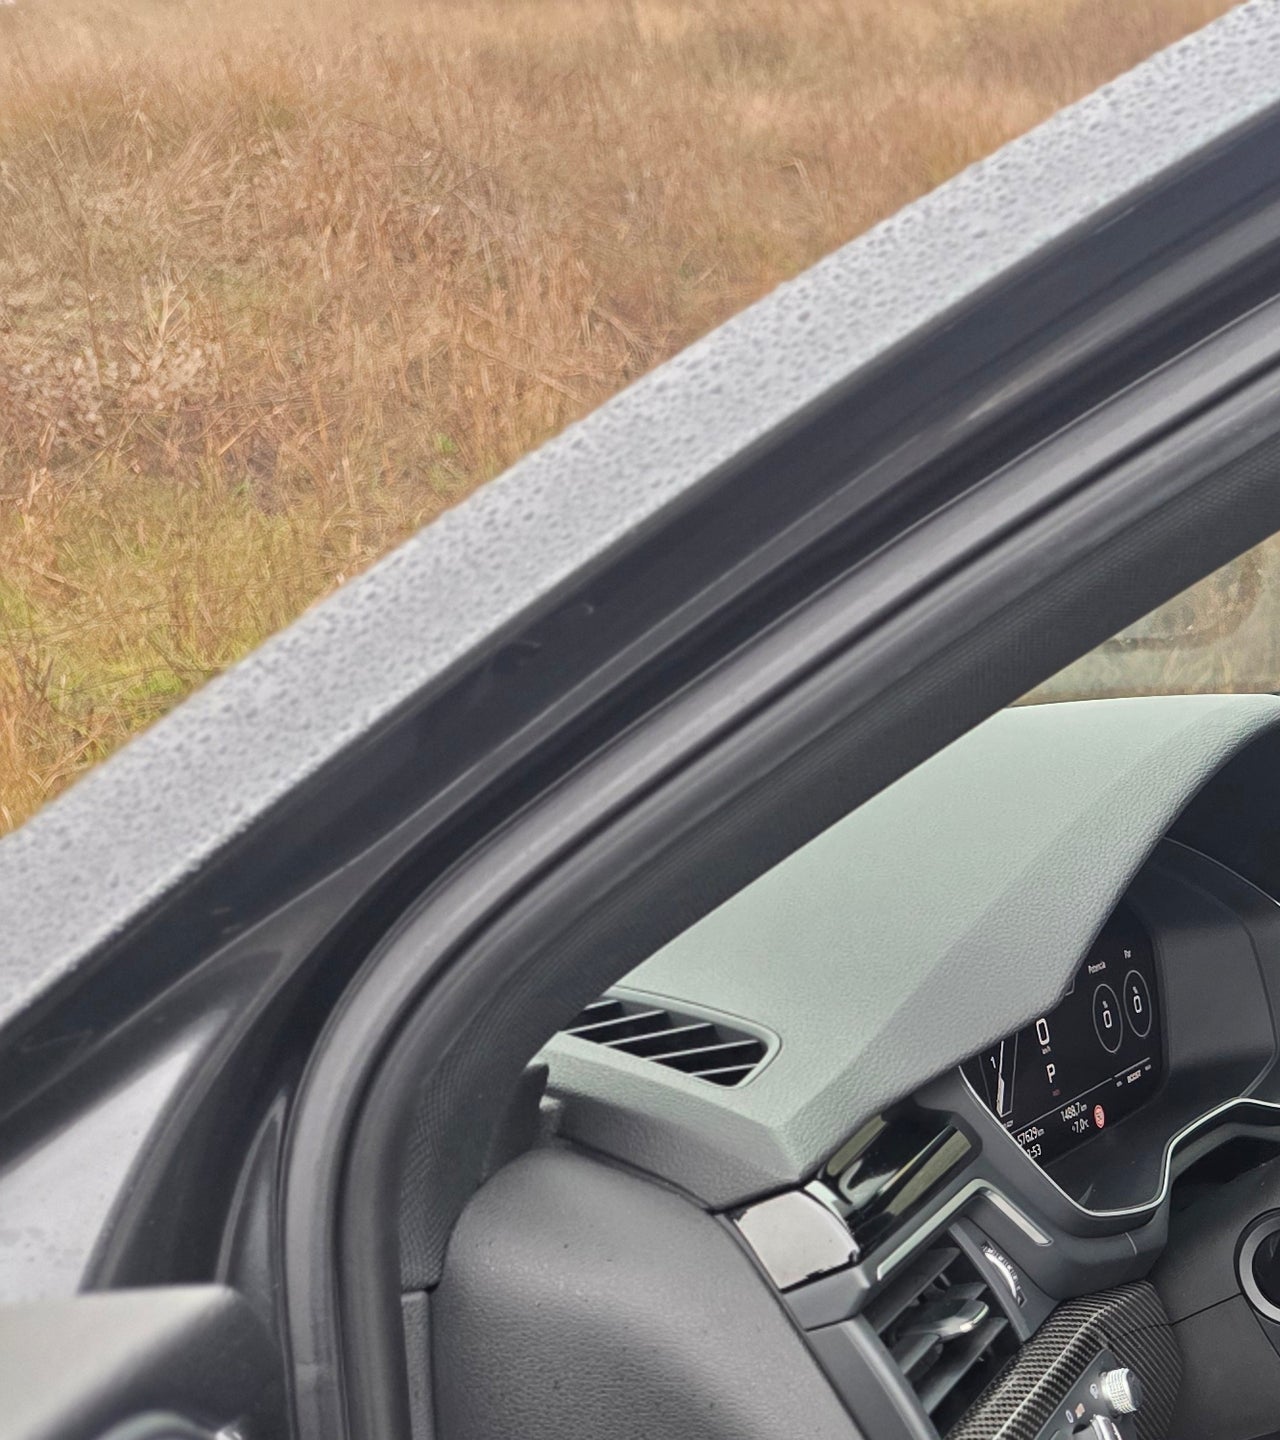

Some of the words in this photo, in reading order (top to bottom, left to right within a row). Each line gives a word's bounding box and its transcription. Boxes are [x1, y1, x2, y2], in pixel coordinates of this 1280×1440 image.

[1133, 995, 1142, 1013] 0
[1103, 1010, 1112, 1028] 0
[1036, 1018, 1050, 1045] 0
[990, 1056, 996, 1069] 1
[1046, 1063, 1056, 1083] P
